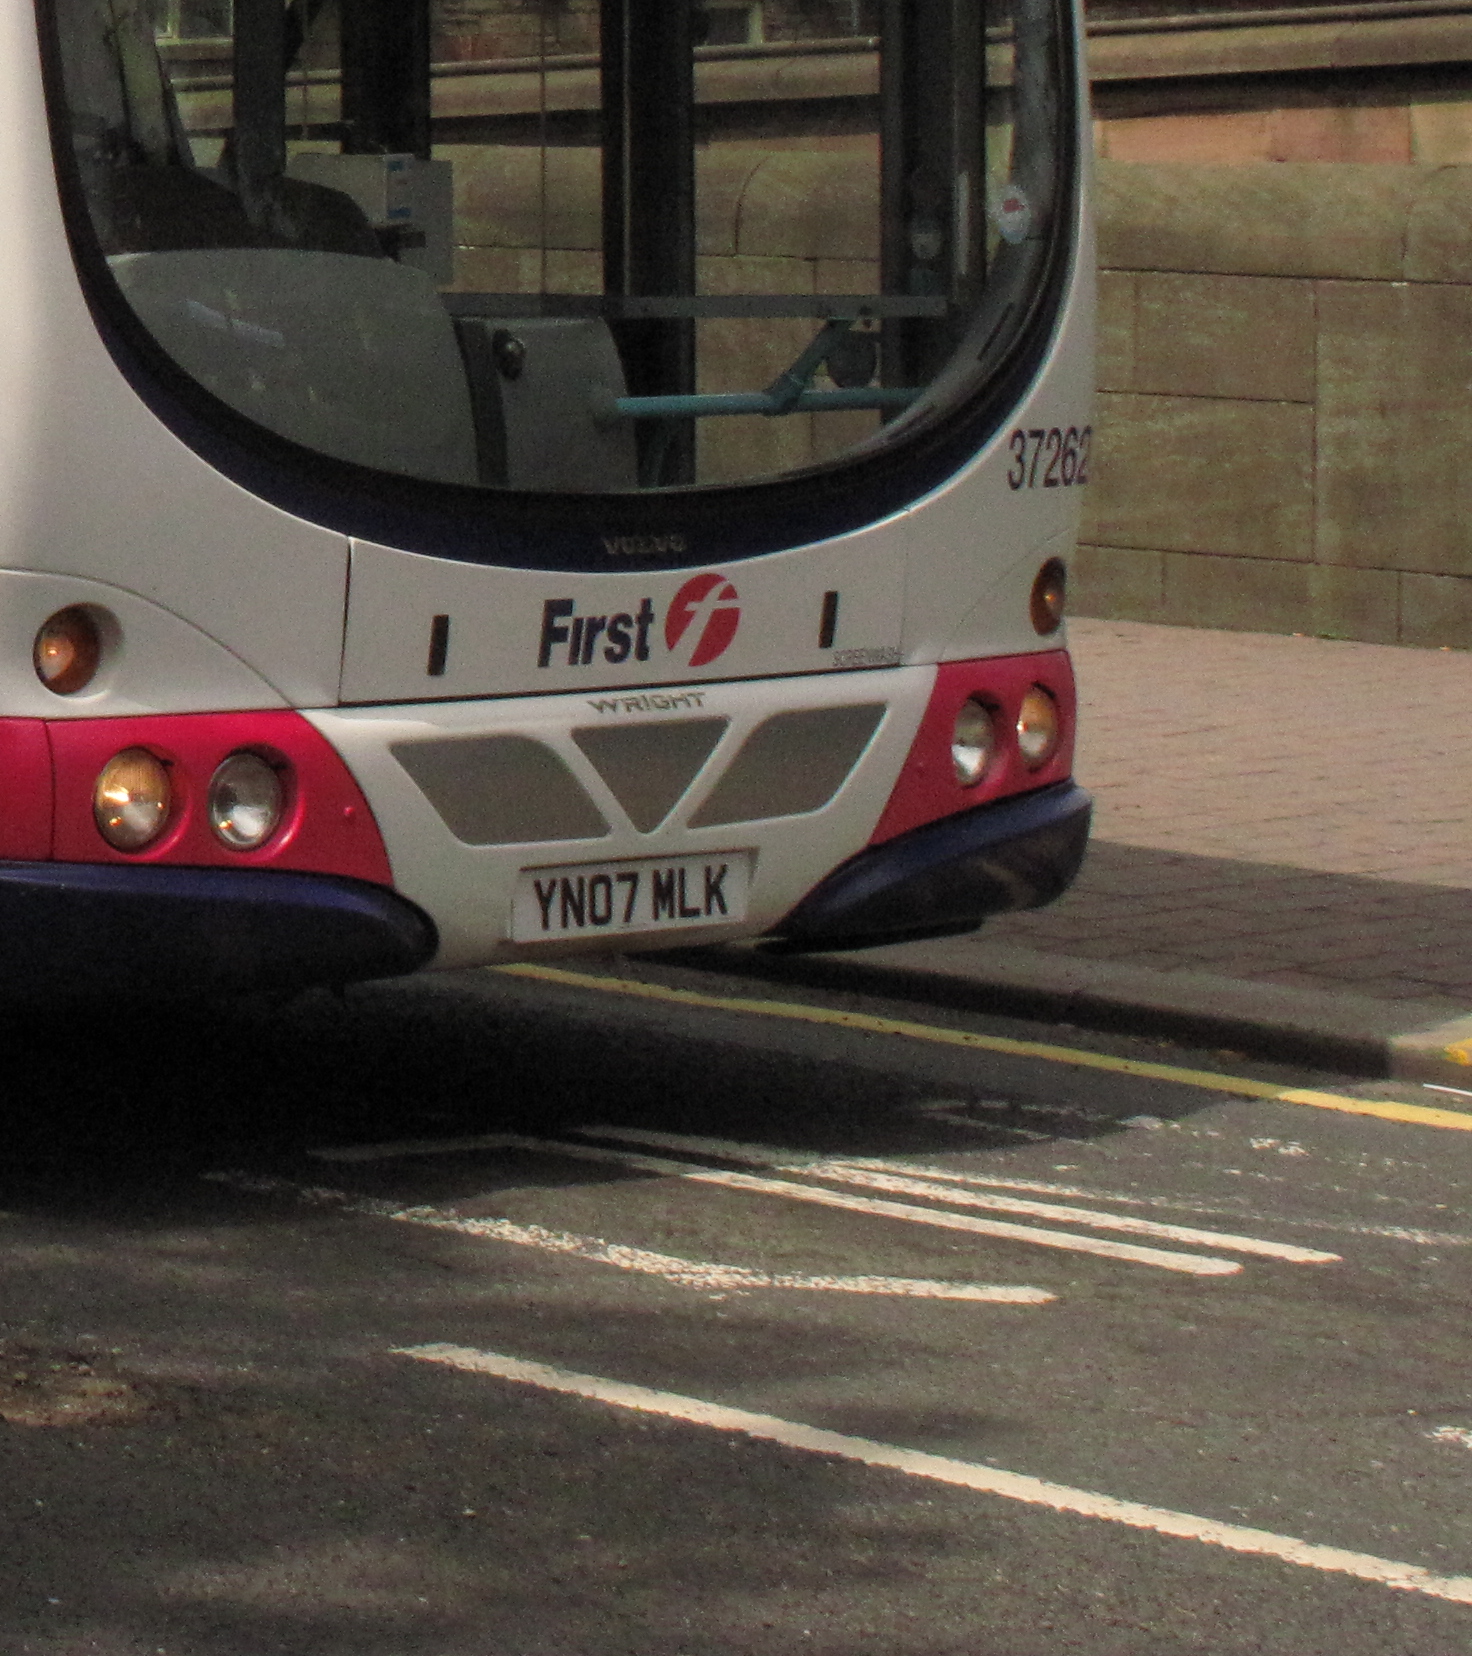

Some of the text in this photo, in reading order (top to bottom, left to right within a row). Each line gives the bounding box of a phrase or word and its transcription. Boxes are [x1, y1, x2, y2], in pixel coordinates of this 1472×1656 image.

[1007, 425, 1092, 491] 37262
[538, 598, 654, 668] First
[587, 692, 706, 713] WRIGHT
[534, 864, 728, 930] YN07 MLK
